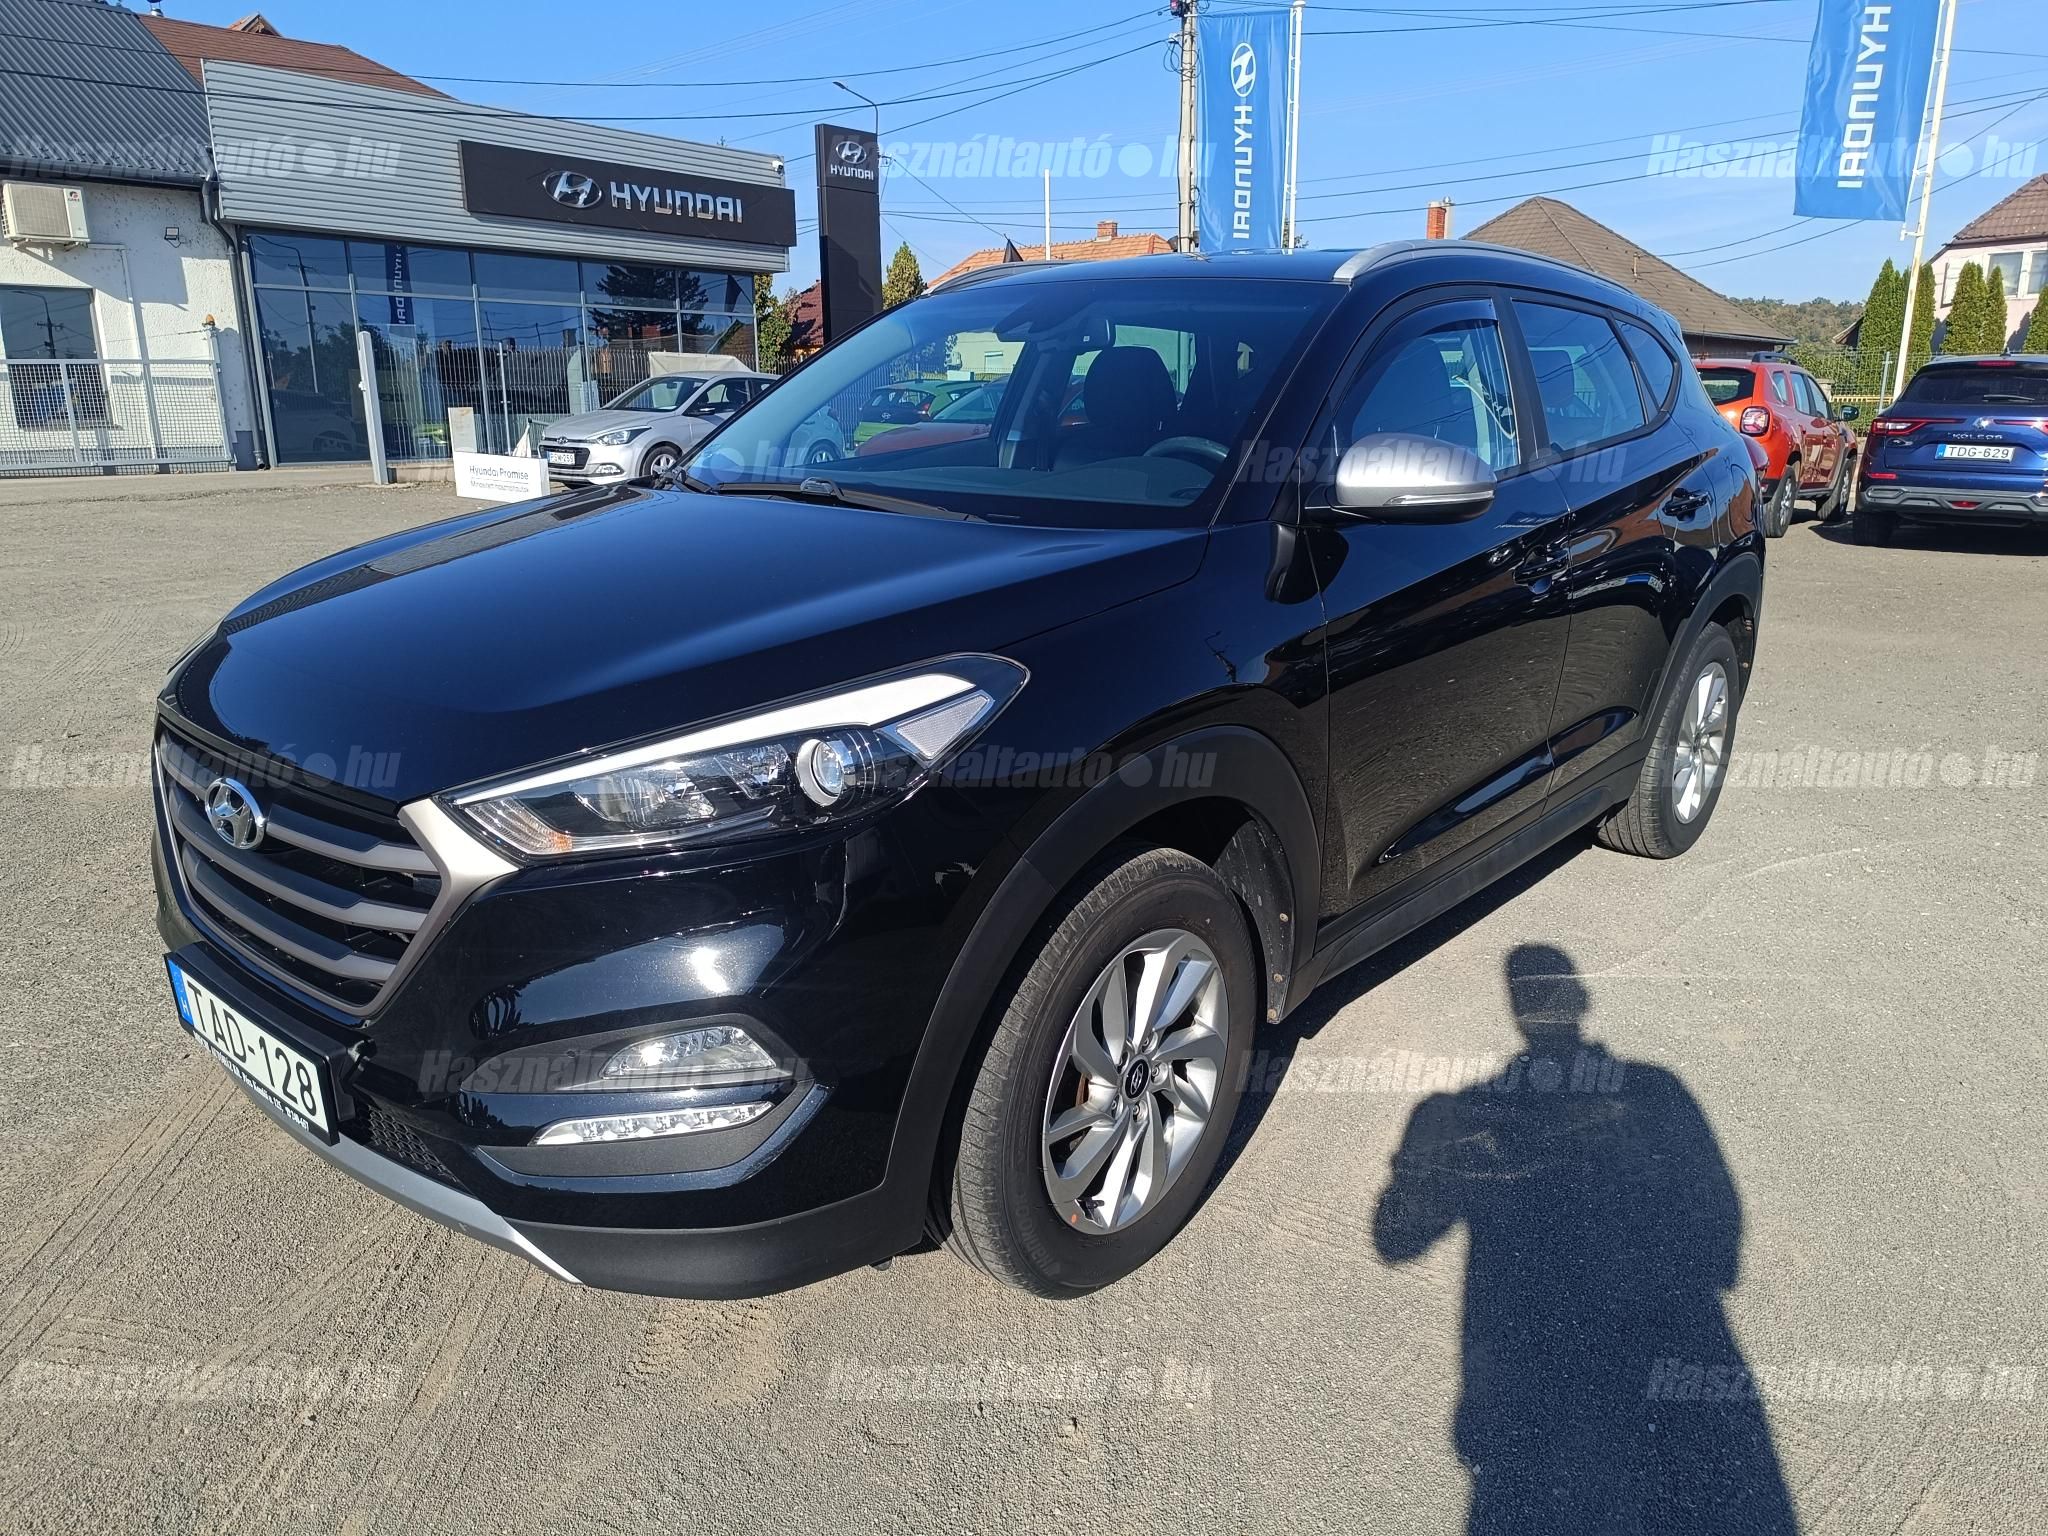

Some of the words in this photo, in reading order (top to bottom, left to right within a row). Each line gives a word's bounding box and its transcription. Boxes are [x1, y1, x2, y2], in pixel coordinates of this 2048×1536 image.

[830, 164, 874, 180] HYUNDAI
[610, 181, 743, 223] HYUNDAI
[1948, 446, 2010, 459] TDG-629
[469, 465, 498, 477] Hyundai
[499, 467, 529, 480] Promise
[187, 980, 317, 1117] TAD-128
